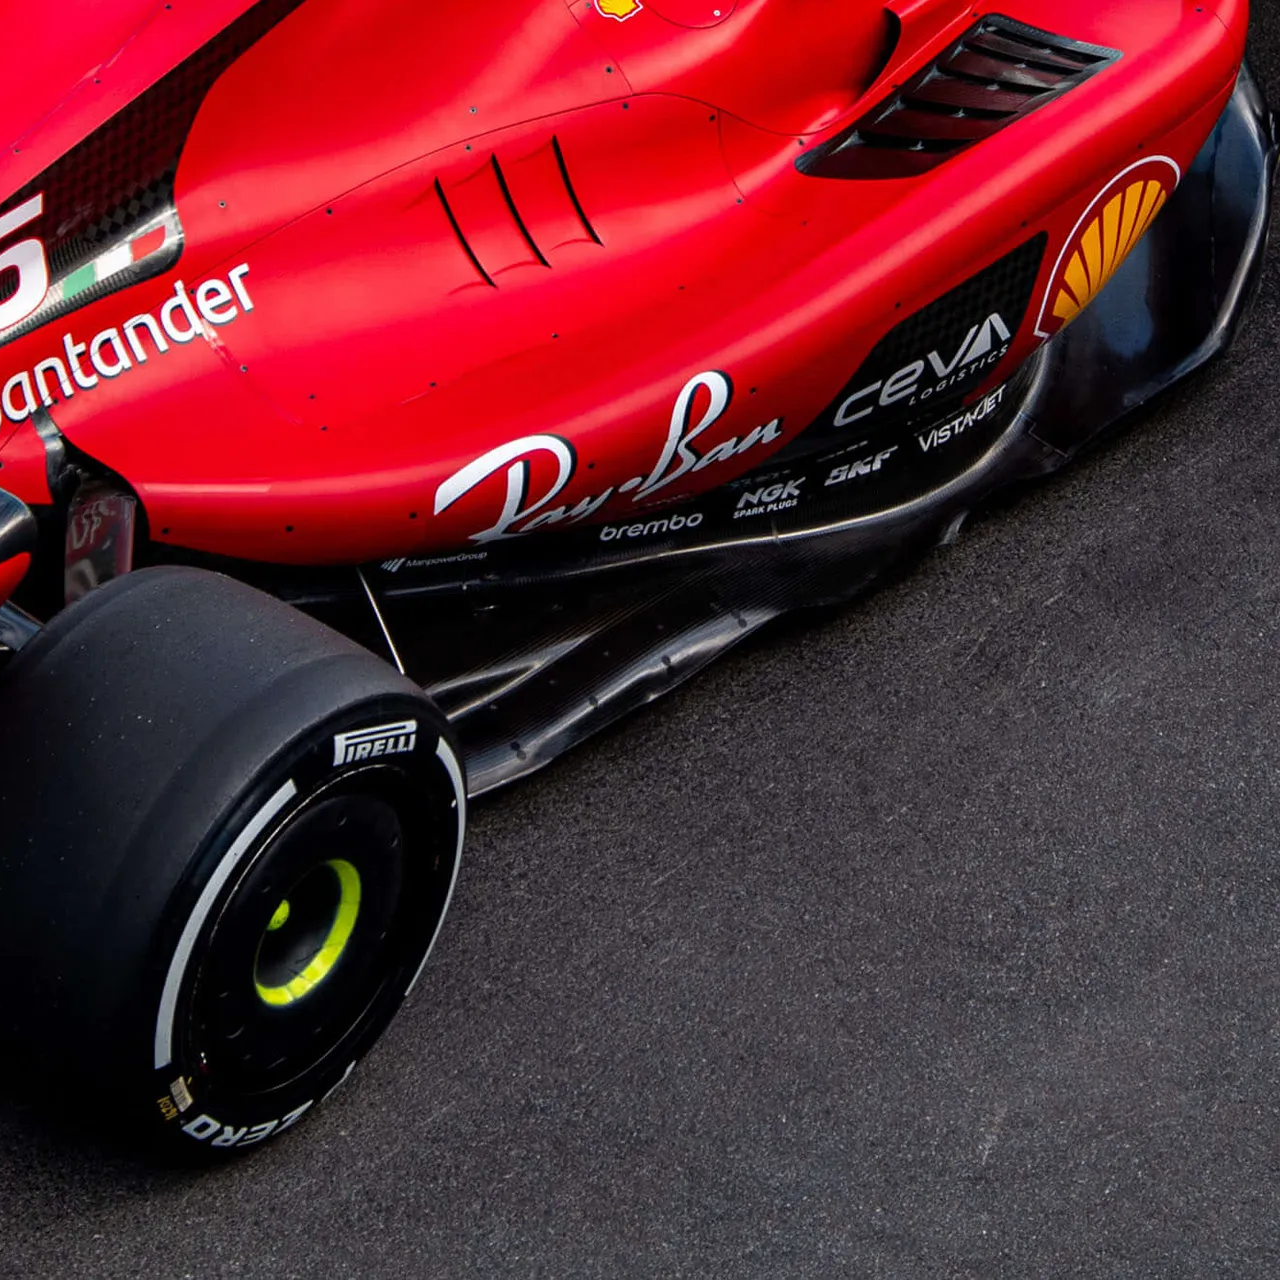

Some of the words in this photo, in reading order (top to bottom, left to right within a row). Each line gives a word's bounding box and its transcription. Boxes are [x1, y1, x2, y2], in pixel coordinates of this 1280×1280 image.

[908, 344, 1009, 406] LOGISTICS
[824, 445, 899, 487] SKF
[733, 506, 765, 519] SPARK
[766, 498, 798, 513] PLUGS
[736, 476, 806, 509] NGK
[600, 512, 703, 542] brembo
[333, 719, 418, 767] PIRELLI
